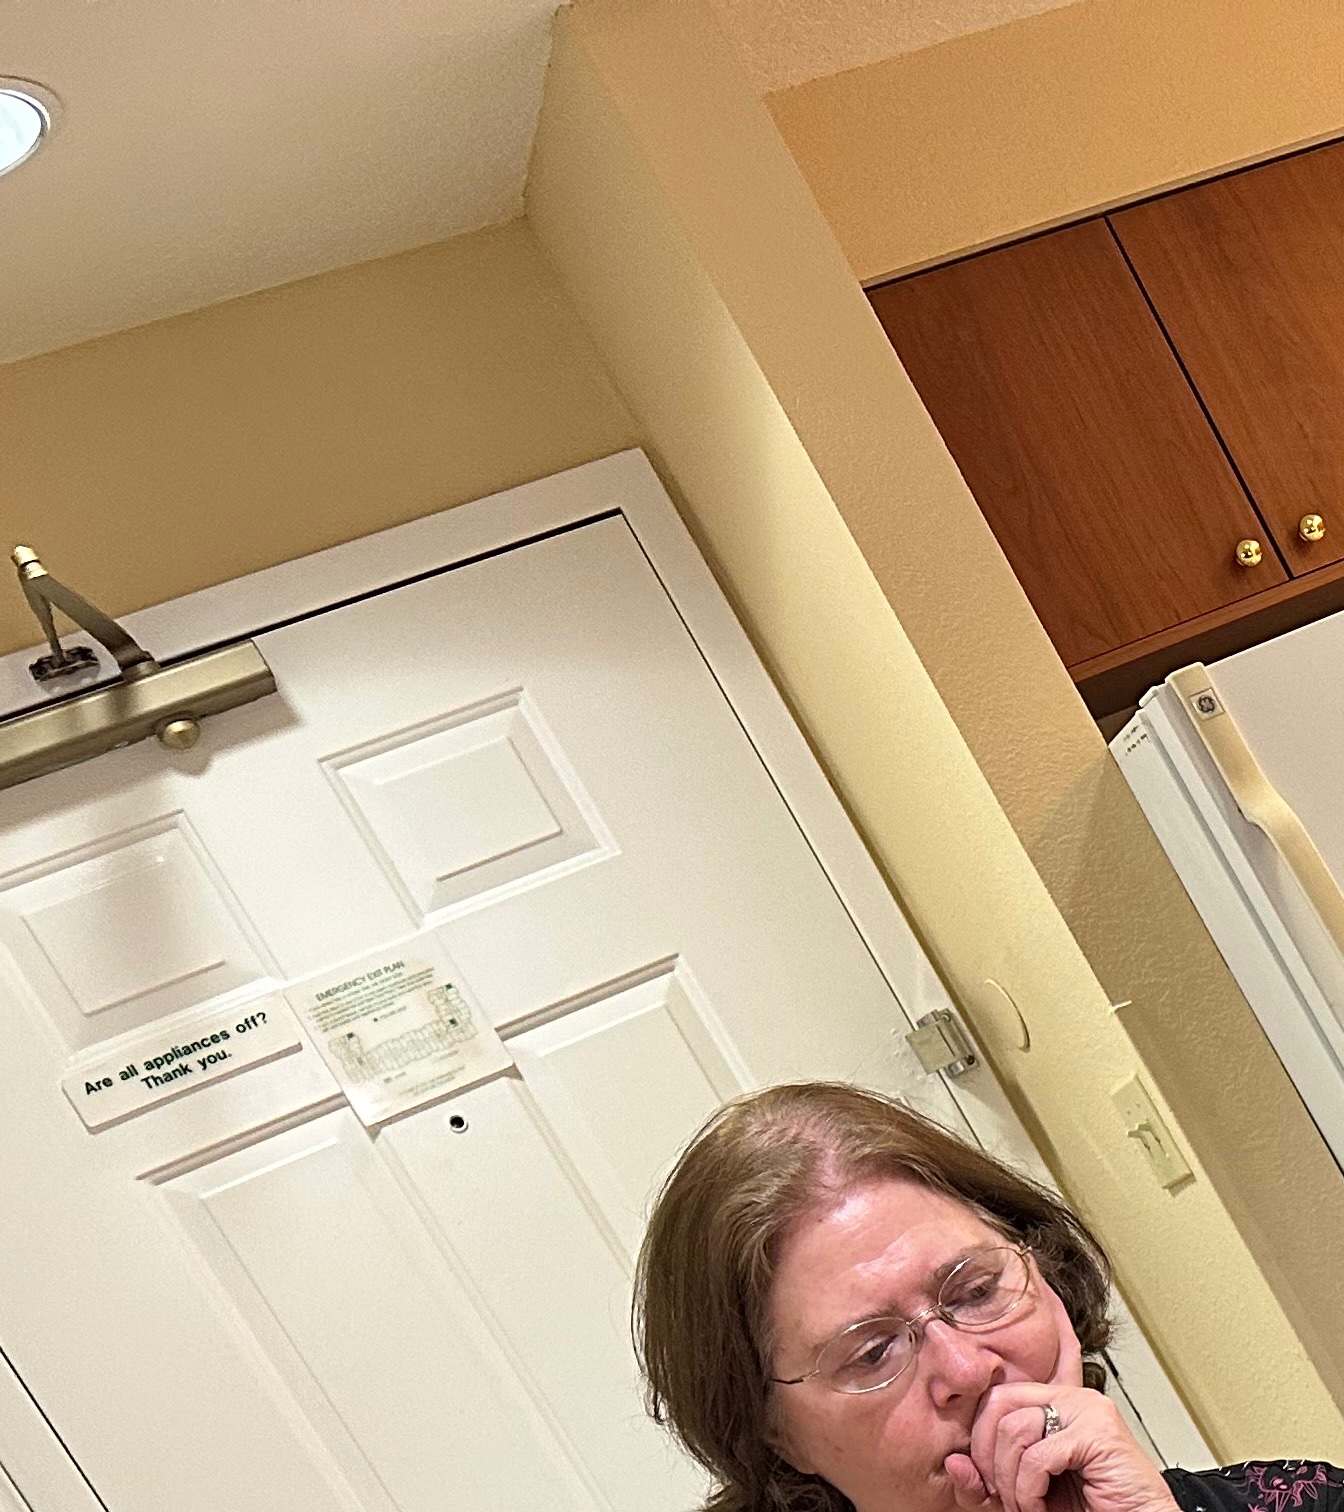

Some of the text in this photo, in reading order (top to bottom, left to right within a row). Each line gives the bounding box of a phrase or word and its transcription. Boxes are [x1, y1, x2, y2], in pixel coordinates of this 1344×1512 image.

[84, 1011, 268, 1095] Are all appliances off?
[140, 1048, 233, 1090] Thank you.
